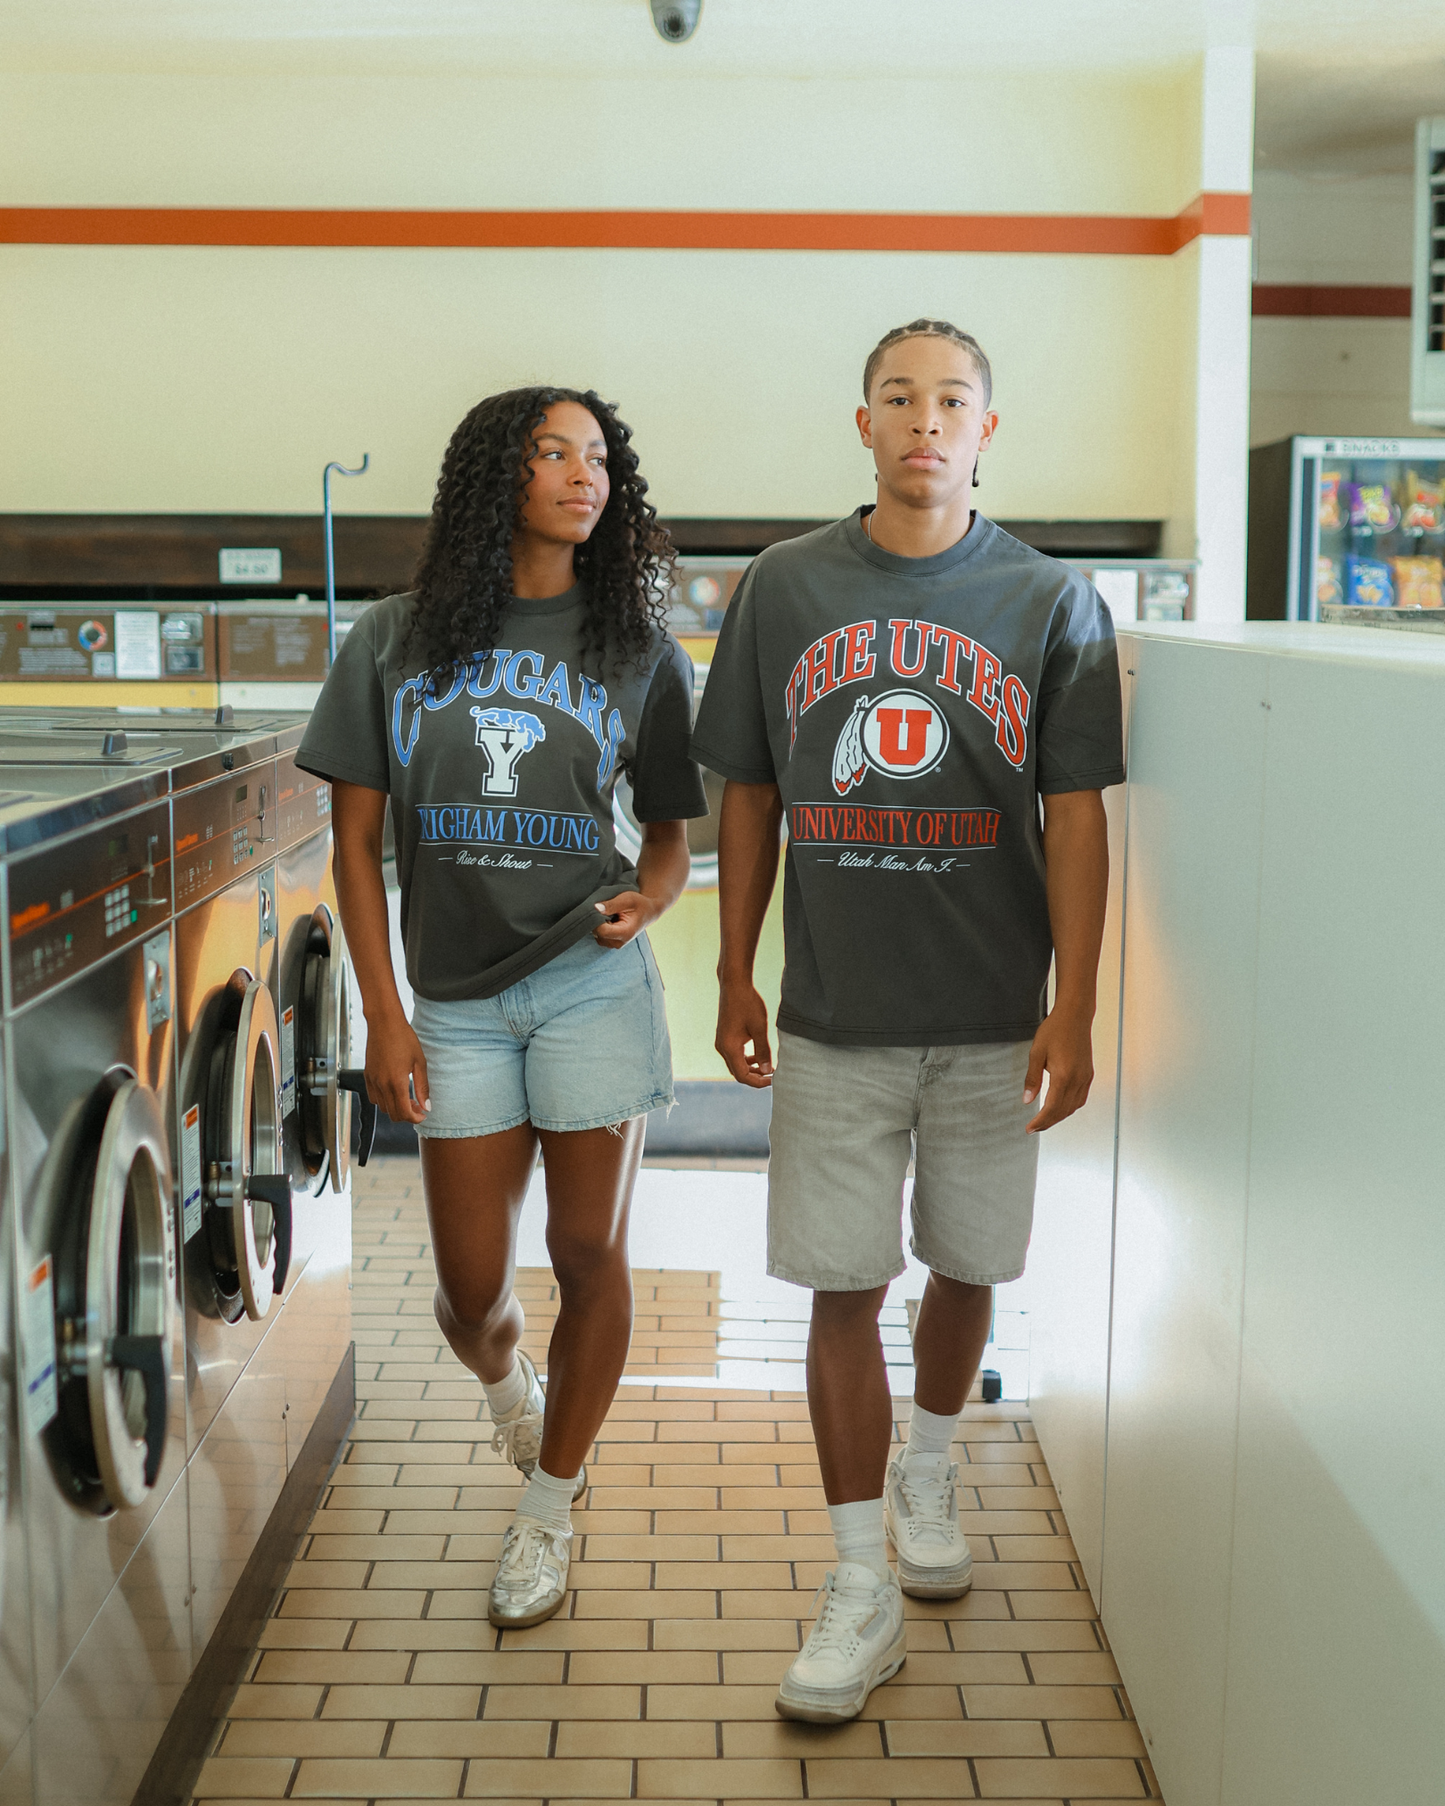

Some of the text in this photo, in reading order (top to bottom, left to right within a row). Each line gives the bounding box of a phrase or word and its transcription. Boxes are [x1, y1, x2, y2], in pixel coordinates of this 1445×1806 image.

[785, 619, 1031, 767] THE UTES
[392, 649, 626, 793] COUGARS
[876, 707, 932, 766] U
[475, 726, 531, 797] Y
[417, 807, 600, 850] RIGHAM YOUNG
[793, 807, 1002, 847] UNIVERSITY OF UTAH
[456, 850, 533, 870] Rise & Shout
[837, 851, 875, 868] Utah
[874, 854, 908, 871] Man
[906, 856, 935, 872] Am
